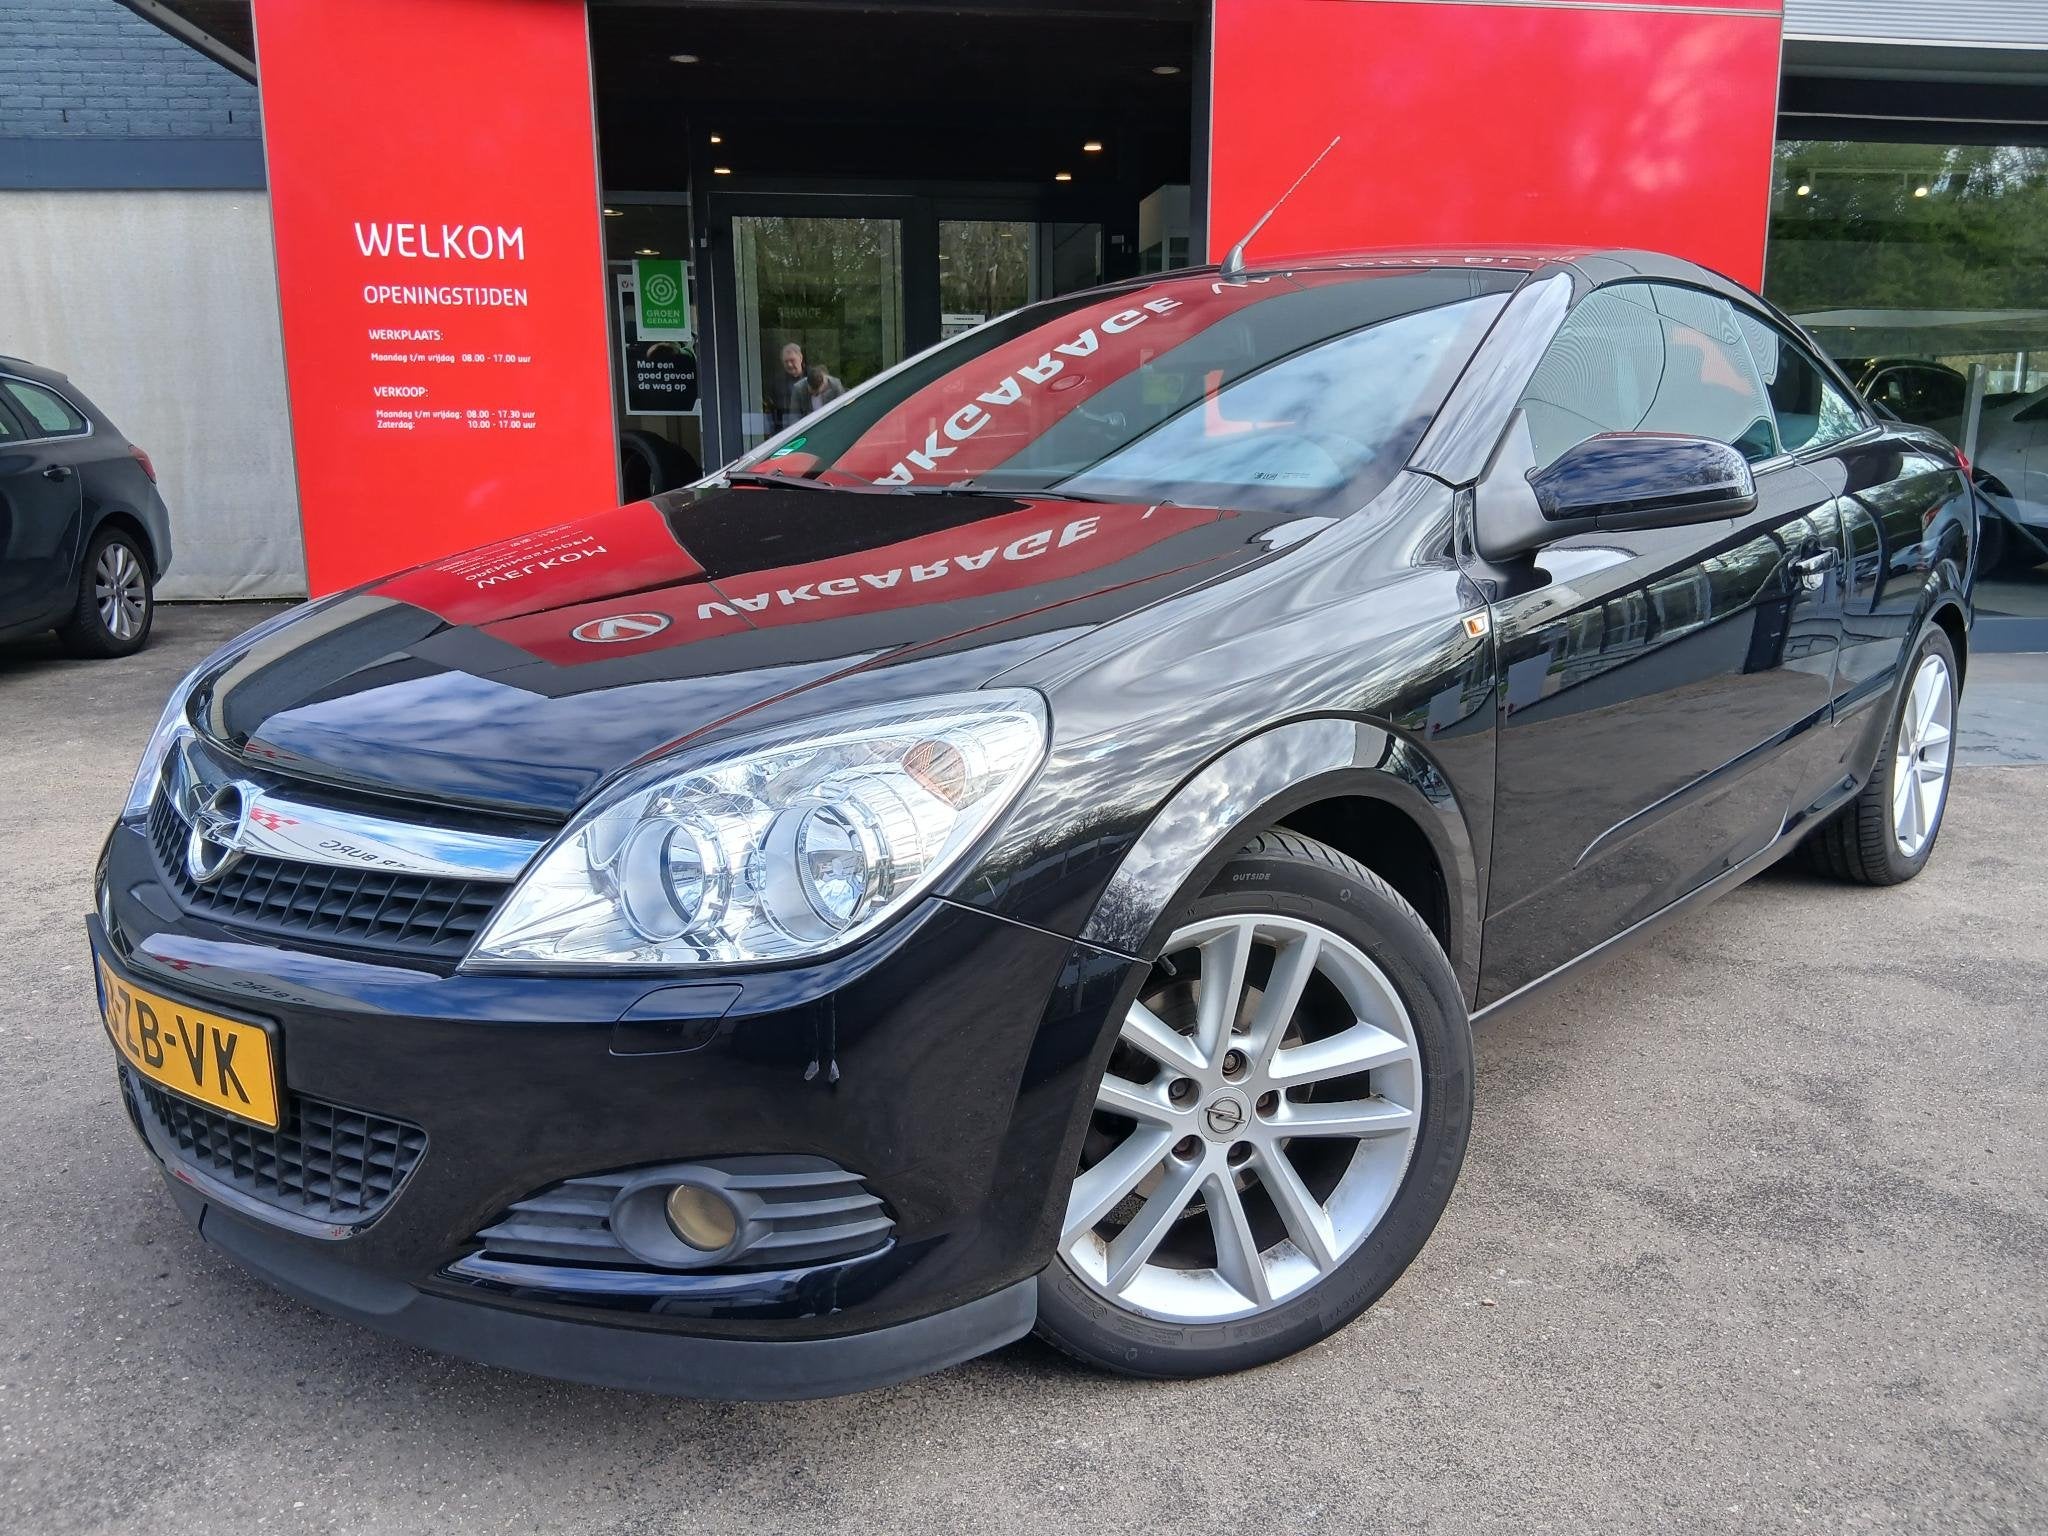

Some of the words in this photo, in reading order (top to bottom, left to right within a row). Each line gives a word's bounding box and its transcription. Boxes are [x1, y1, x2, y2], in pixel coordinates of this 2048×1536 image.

[354, 222, 525, 260] WELKOM
[363, 285, 528, 306] OPENINGSTIJDEN
[646, 309, 680, 318] GROEN
[368, 329, 444, 341] WERKPLAATS:
[371, 353, 407, 362] Maandag
[409, 353, 426, 362] t/m
[462, 354, 485, 362] 08.00
[493, 354, 516, 363] 17.00
[637, 361, 654, 369] Met
[638, 372, 661, 381] goed
[664, 372, 694, 381] gevoel
[638, 382, 650, 390] de
[652, 384, 672, 392] weg
[674, 384, 687, 392] op
[374, 387, 428, 398] VERKOOP:
[376, 410, 412, 419] Maandag
[414, 410, 431, 419] t/m
[466, 410, 490, 418] 08.00
[498, 410, 520, 418] 17.30
[468, 420, 491, 429] 10.00
[499, 420, 521, 429] 17.00
[1232, 872, 1271, 881] OUTSIDE
